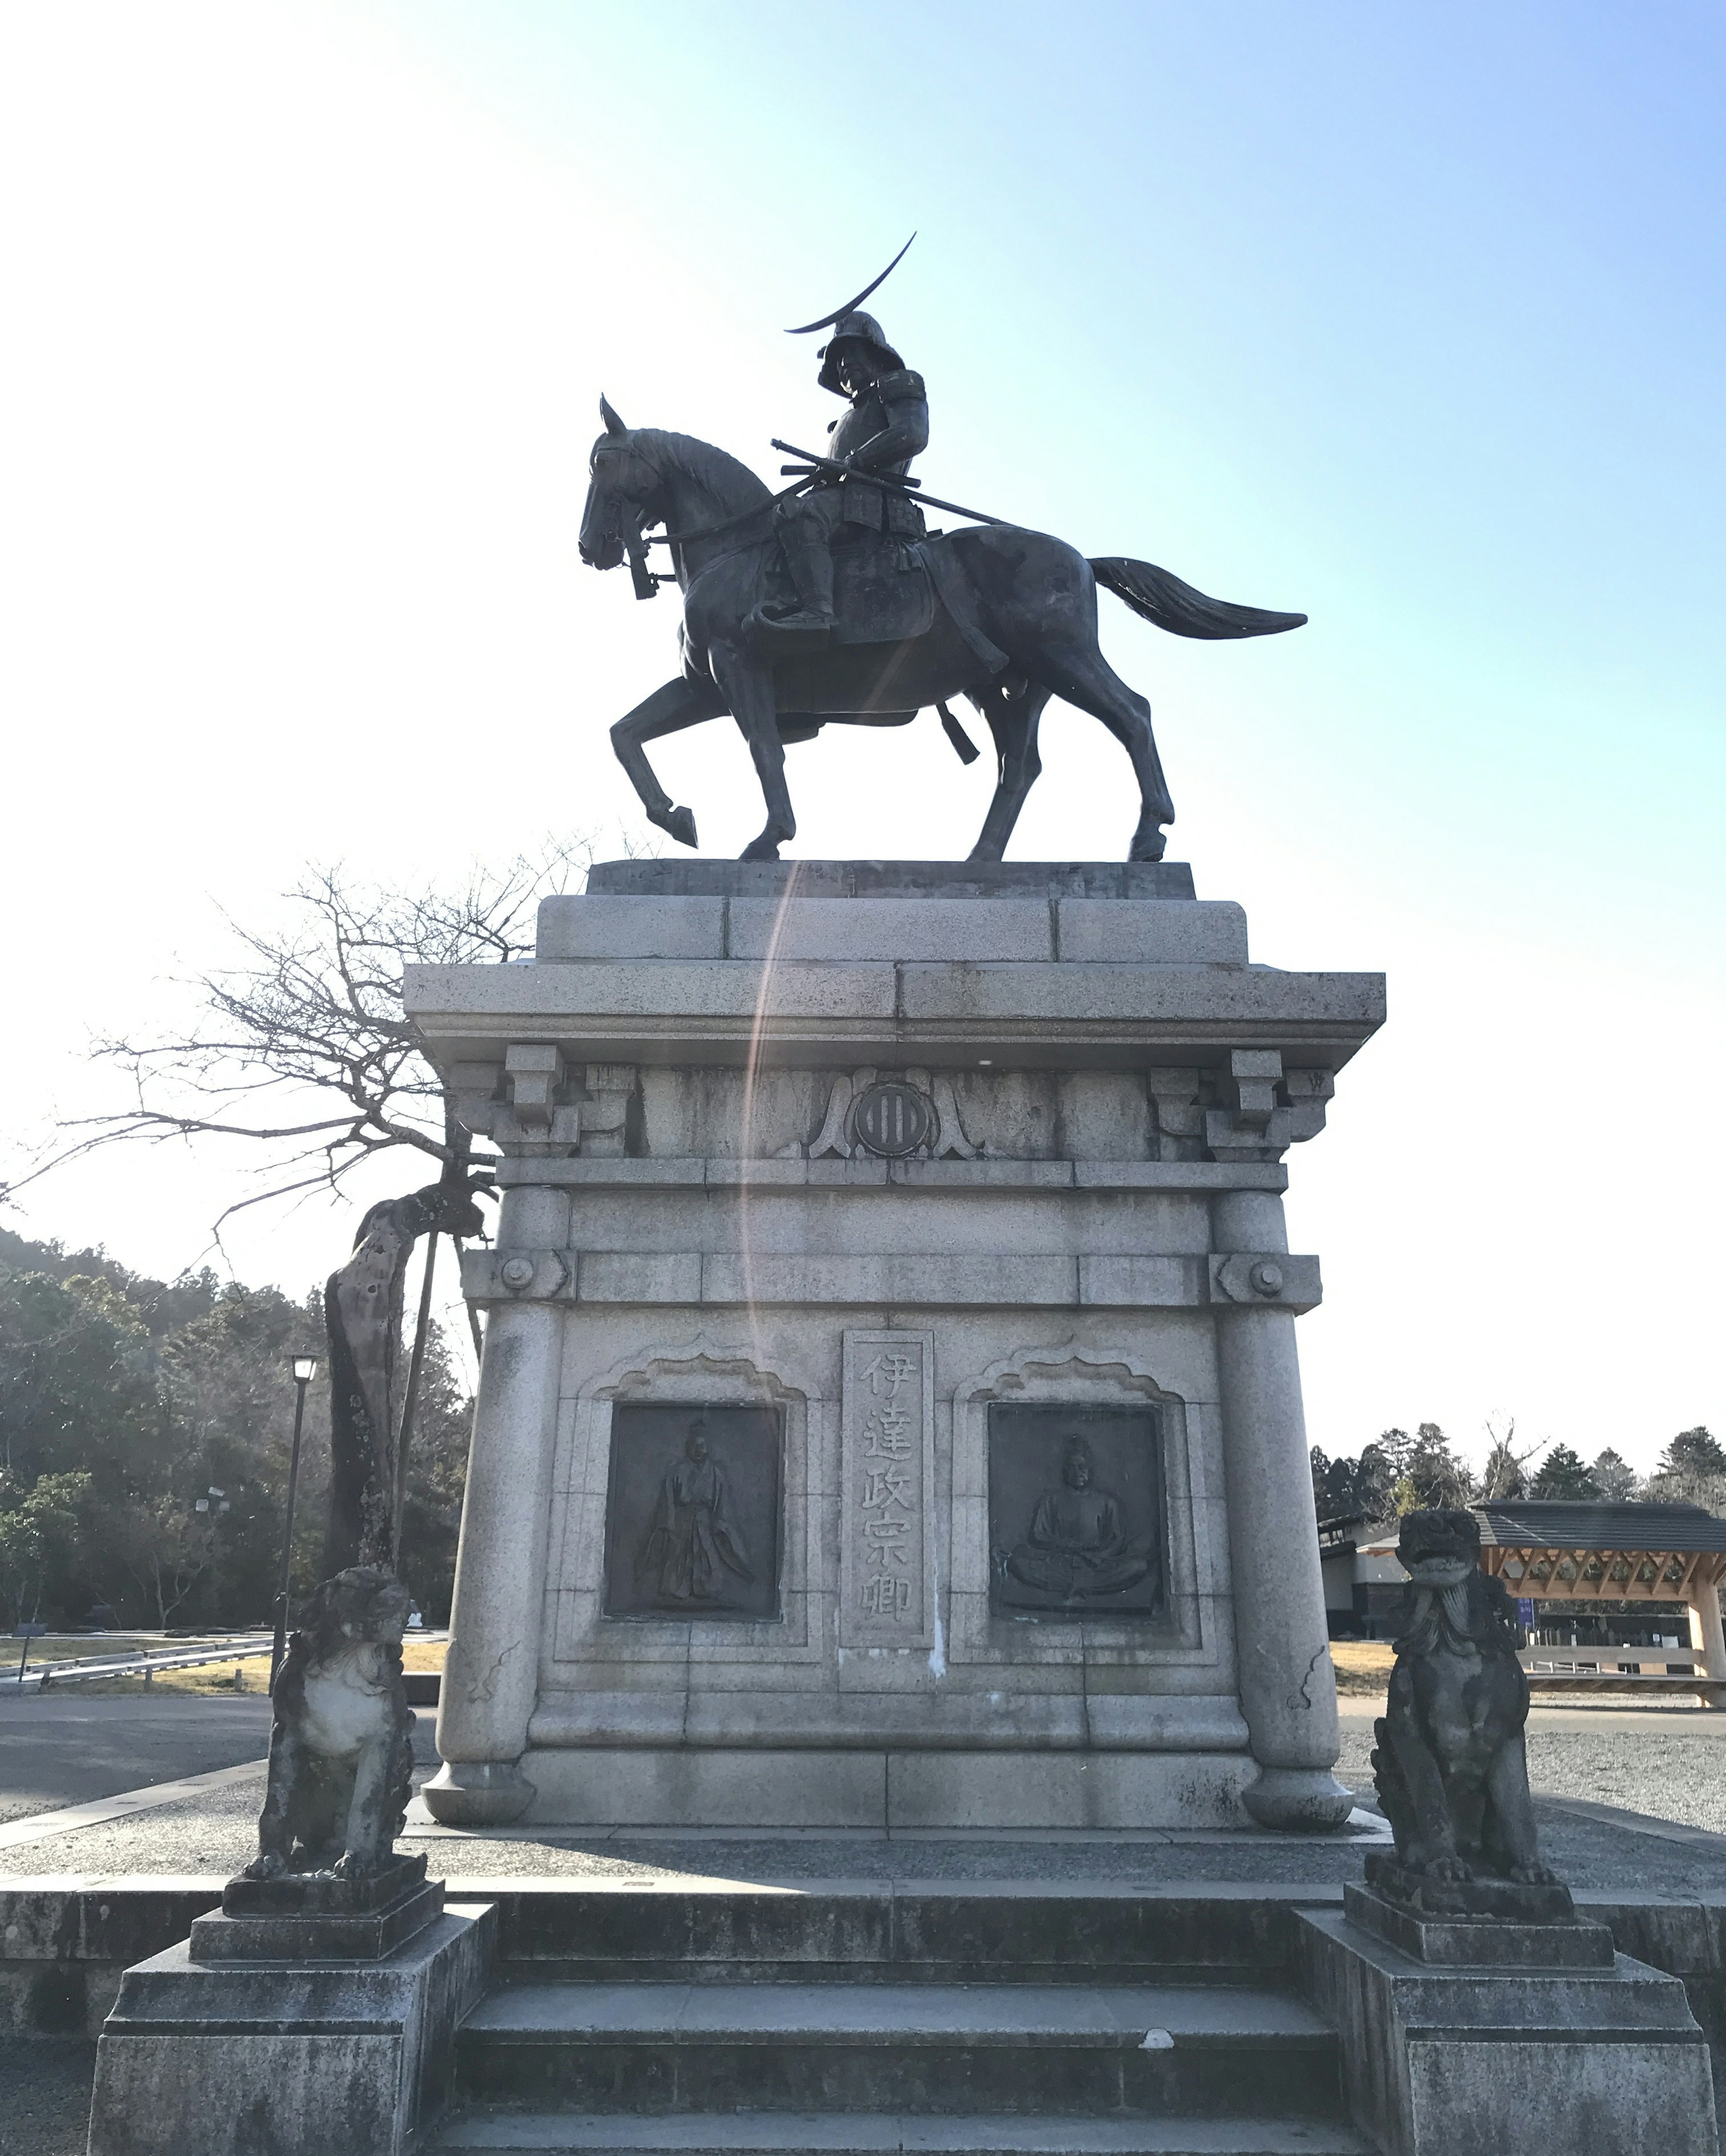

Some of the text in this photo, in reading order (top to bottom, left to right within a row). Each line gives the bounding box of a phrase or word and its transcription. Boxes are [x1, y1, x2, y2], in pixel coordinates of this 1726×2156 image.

[859, 1352, 917, 1621] 伊達政宗卿
